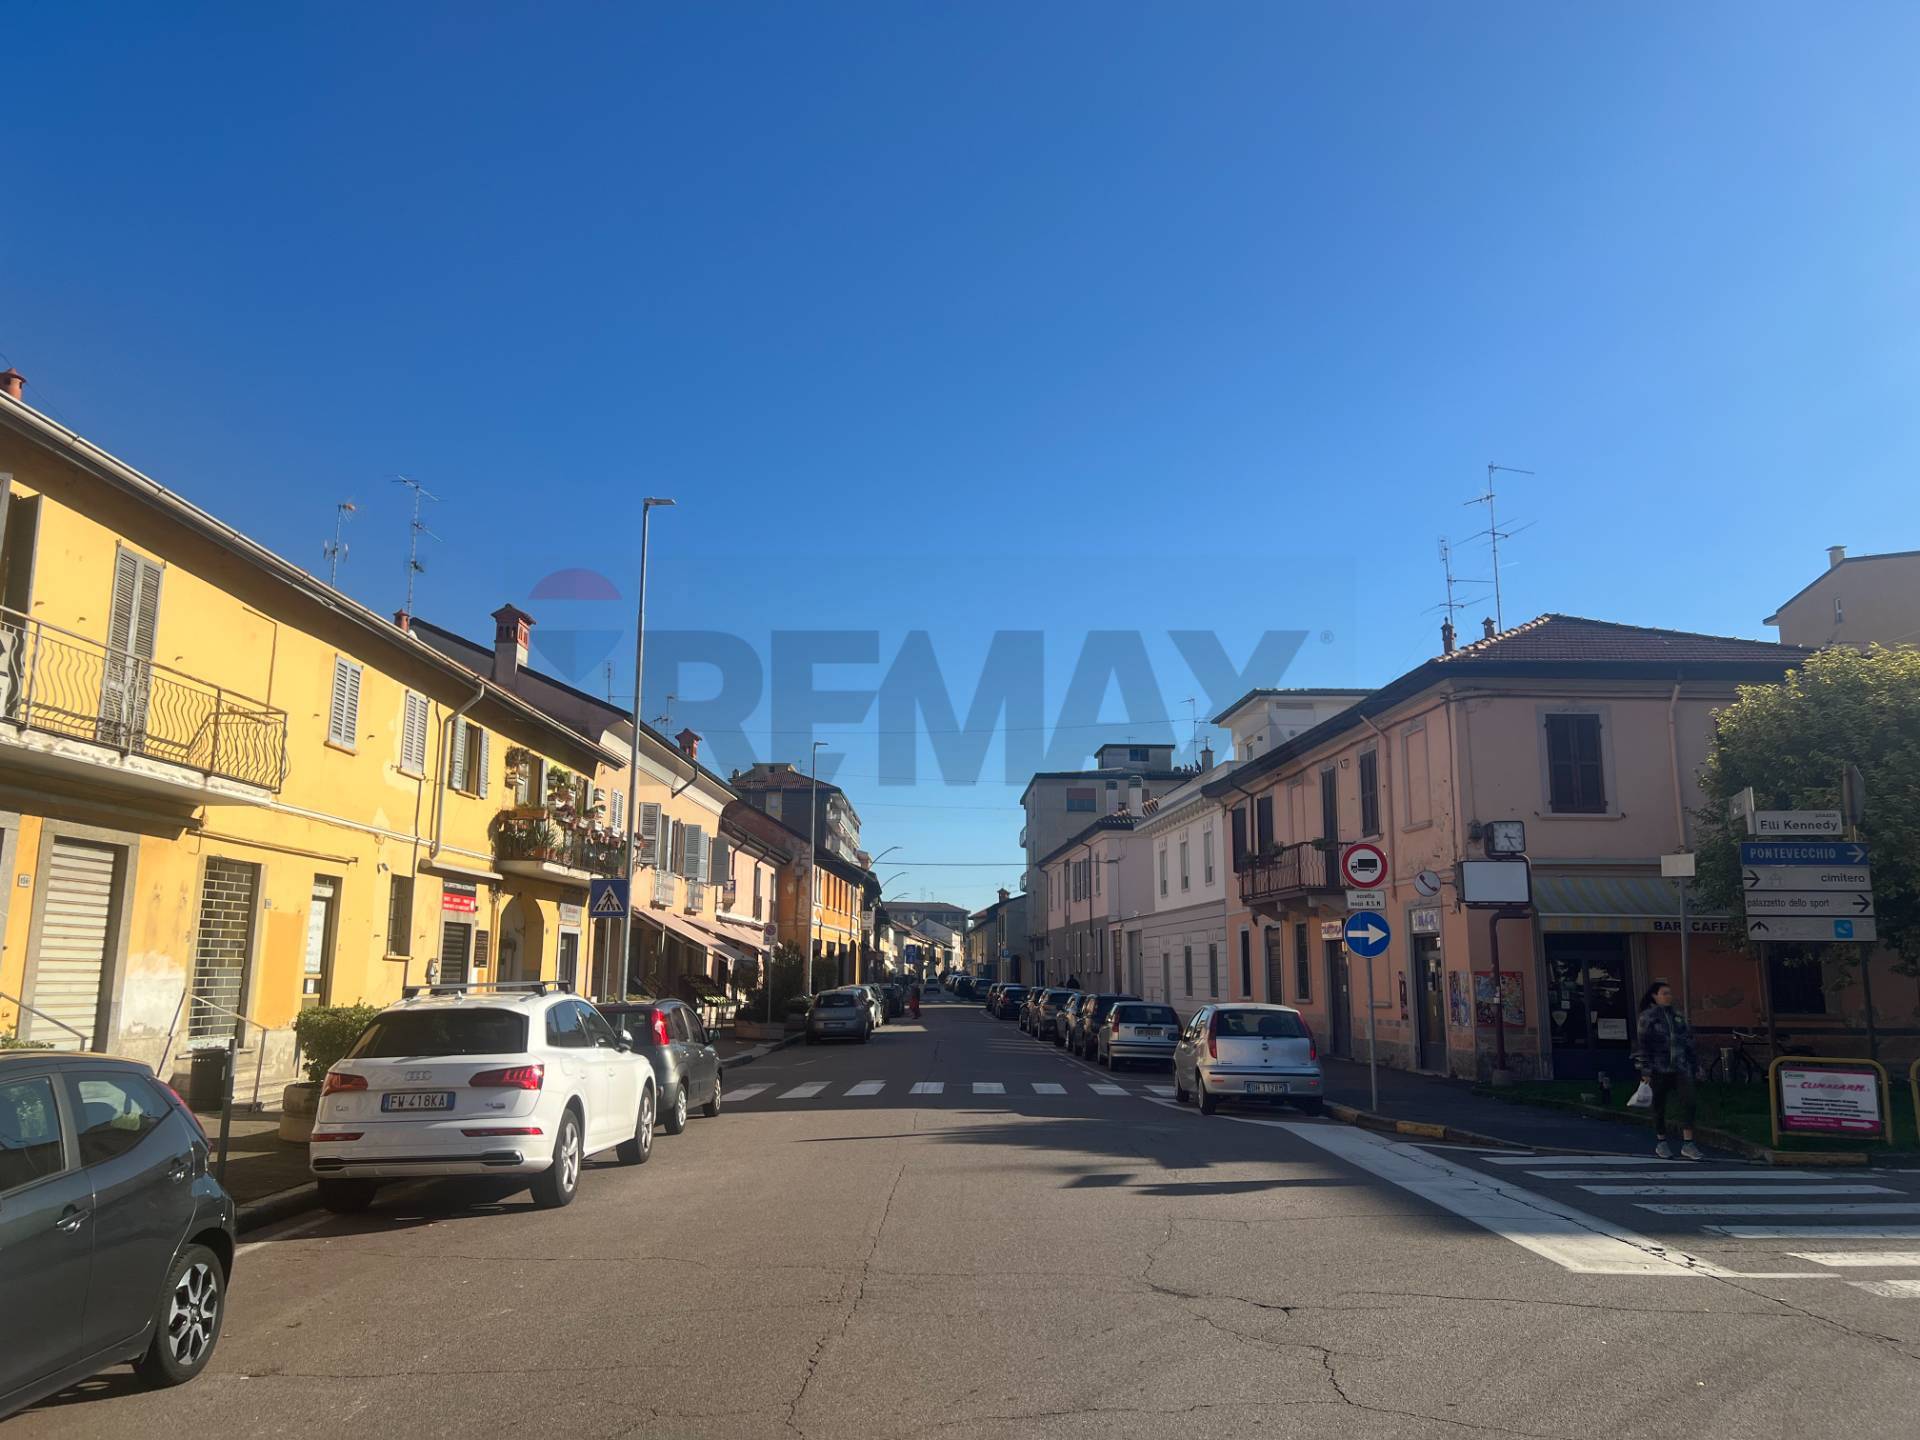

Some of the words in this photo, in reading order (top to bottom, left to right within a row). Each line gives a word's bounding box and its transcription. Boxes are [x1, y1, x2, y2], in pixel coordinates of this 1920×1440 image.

[1784, 820, 1838, 832] Kennedy
[1750, 848, 1837, 860] PONTEVECCHIO
[1820, 873, 1866, 884] cimitero
[1747, 898, 1786, 909] palazzetto
[1788, 898, 1808, 908] dello
[1810, 898, 1830, 910] sport
[1653, 921, 1682, 931] BAR
[1691, 922, 1730, 932] CAFF
